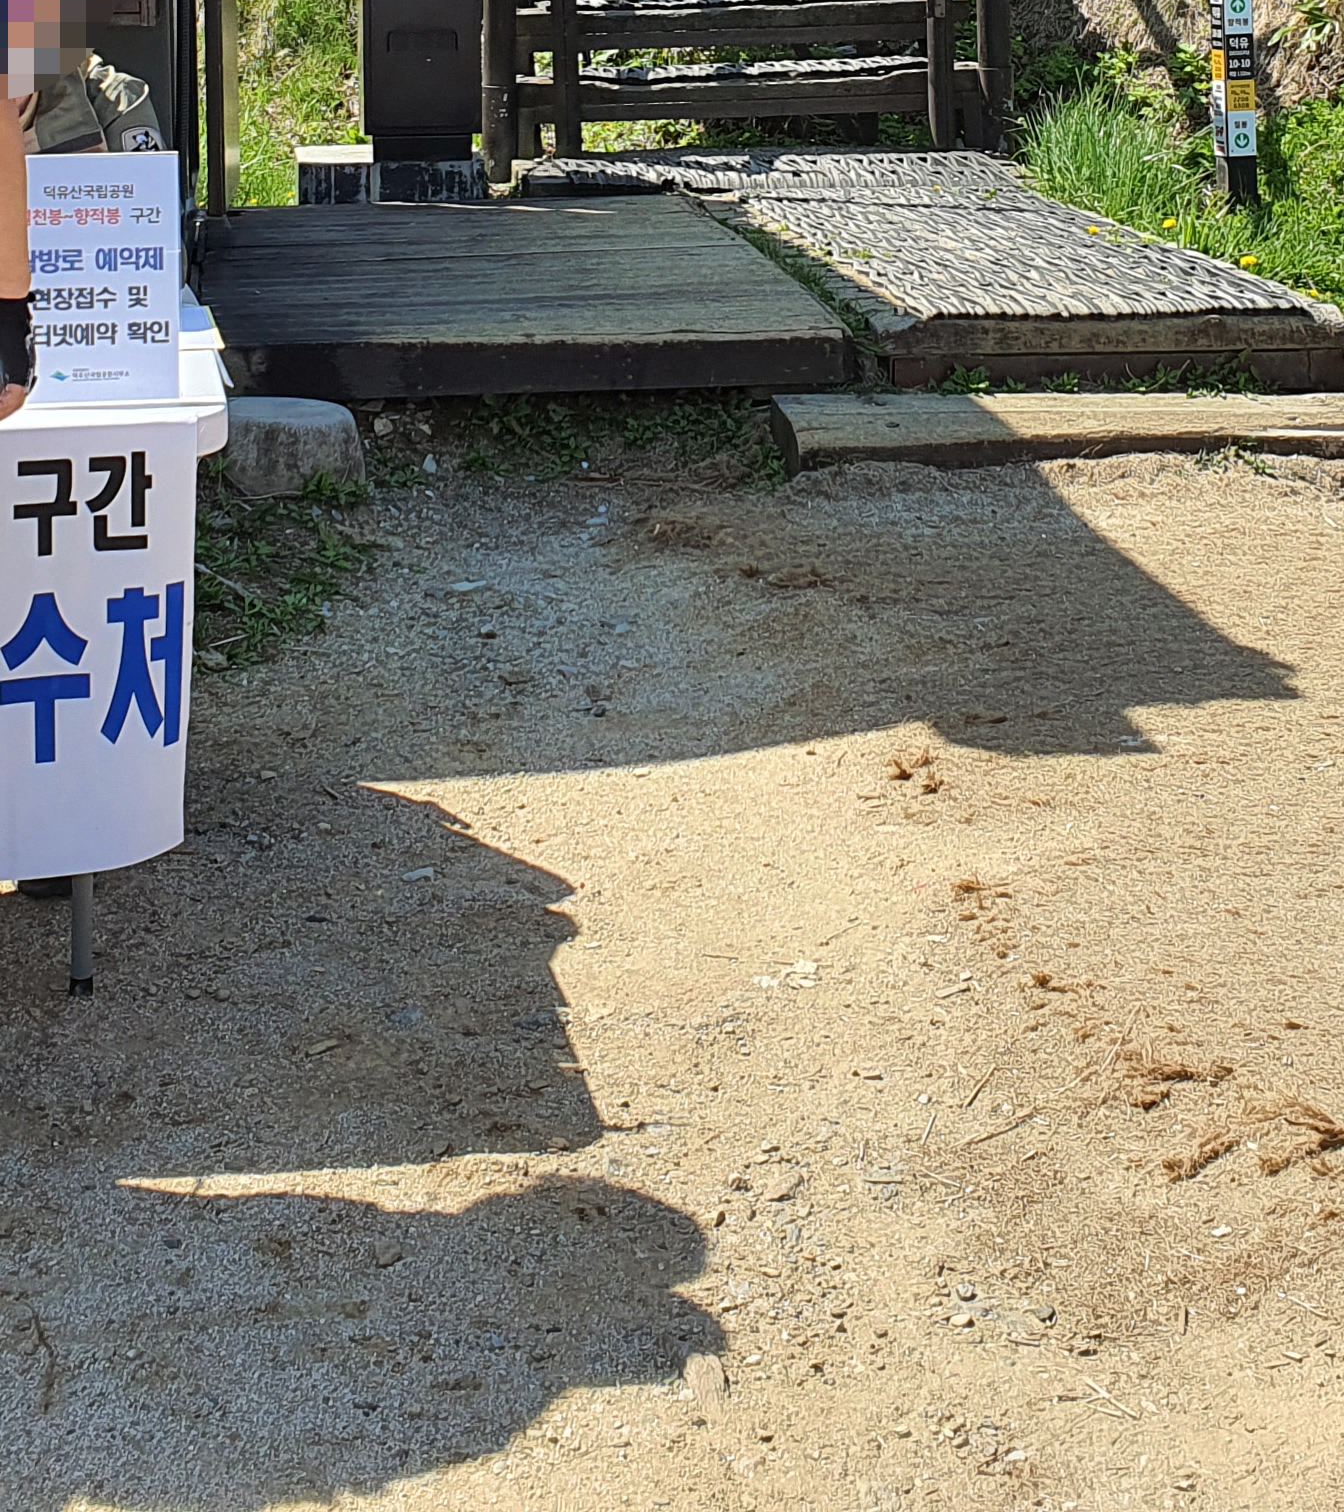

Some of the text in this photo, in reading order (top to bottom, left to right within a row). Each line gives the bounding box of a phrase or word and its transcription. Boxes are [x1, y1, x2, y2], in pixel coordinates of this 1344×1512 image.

[1229, 37, 1249, 49] 덕유
[1229, 59, 1251, 68] 10-10
[44, 184, 134, 199] 덕유산국립공원
[130, 206, 162, 224] 구간
[95, 246, 164, 272] 예약제
[32, 285, 148, 311] 현장접수 및
[127, 320, 170, 344] 확인
[13, 450, 153, 557] 구간
